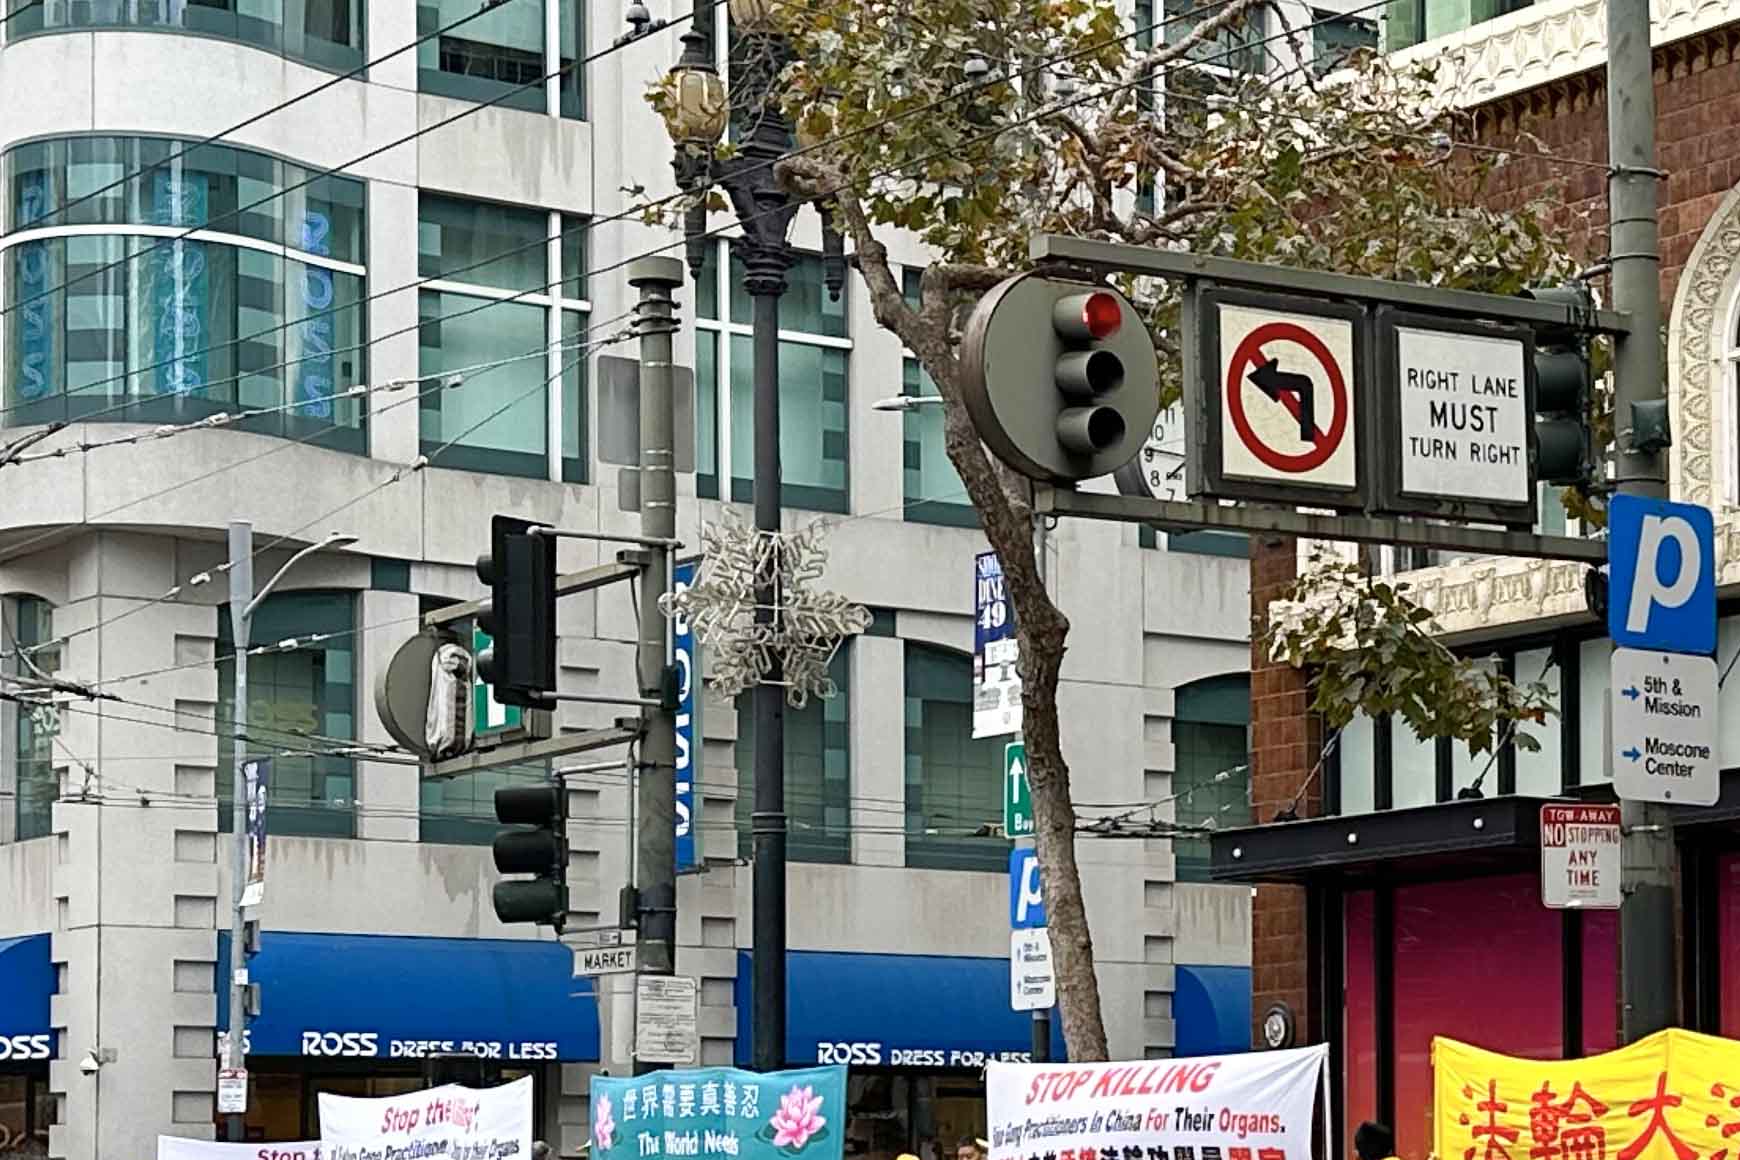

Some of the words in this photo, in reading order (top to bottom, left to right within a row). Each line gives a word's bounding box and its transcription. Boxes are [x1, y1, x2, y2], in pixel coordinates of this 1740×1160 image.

[1407, 367, 1459, 392] RIGHT
[1471, 374, 1518, 399] LANE
[1429, 400, 1498, 433] MUST
[1408, 436, 1457, 460] TURN
[1470, 441, 1521, 466] RIGHT
[1150, 470, 1161, 487] 8
[977, 600, 1007, 630] 49
[1643, 674, 1668, 696] 5th
[1672, 677, 1683, 697] &
[1644, 695, 1701, 719] Mission
[1644, 737, 1711, 760] Moscone
[1644, 757, 1695, 779] Center
[1544, 823, 1565, 846] NO
[1567, 826, 1619, 845] STOPPING
[1568, 849, 1598, 866] ANY
[1566, 869, 1600, 887] TIME
[583, 950, 632, 970] MARKET
[302, 1031, 378, 1057] ROSS
[508, 1042, 558, 1060] LESS
[817, 1042, 882, 1065] ROSS
[890, 1050, 945, 1067] DRESS
[950, 1050, 983, 1067] FOR
[1025, 1069, 1093, 1106] STOP
[1090, 1061, 1222, 1099] KILLING
[380, 1106, 420, 1135] Stop
[1104, 1109, 1141, 1134] China
[1144, 1107, 1168, 1132] For
[1174, 1106, 1215, 1133] Their
[1218, 1107, 1286, 1140] Organs.
